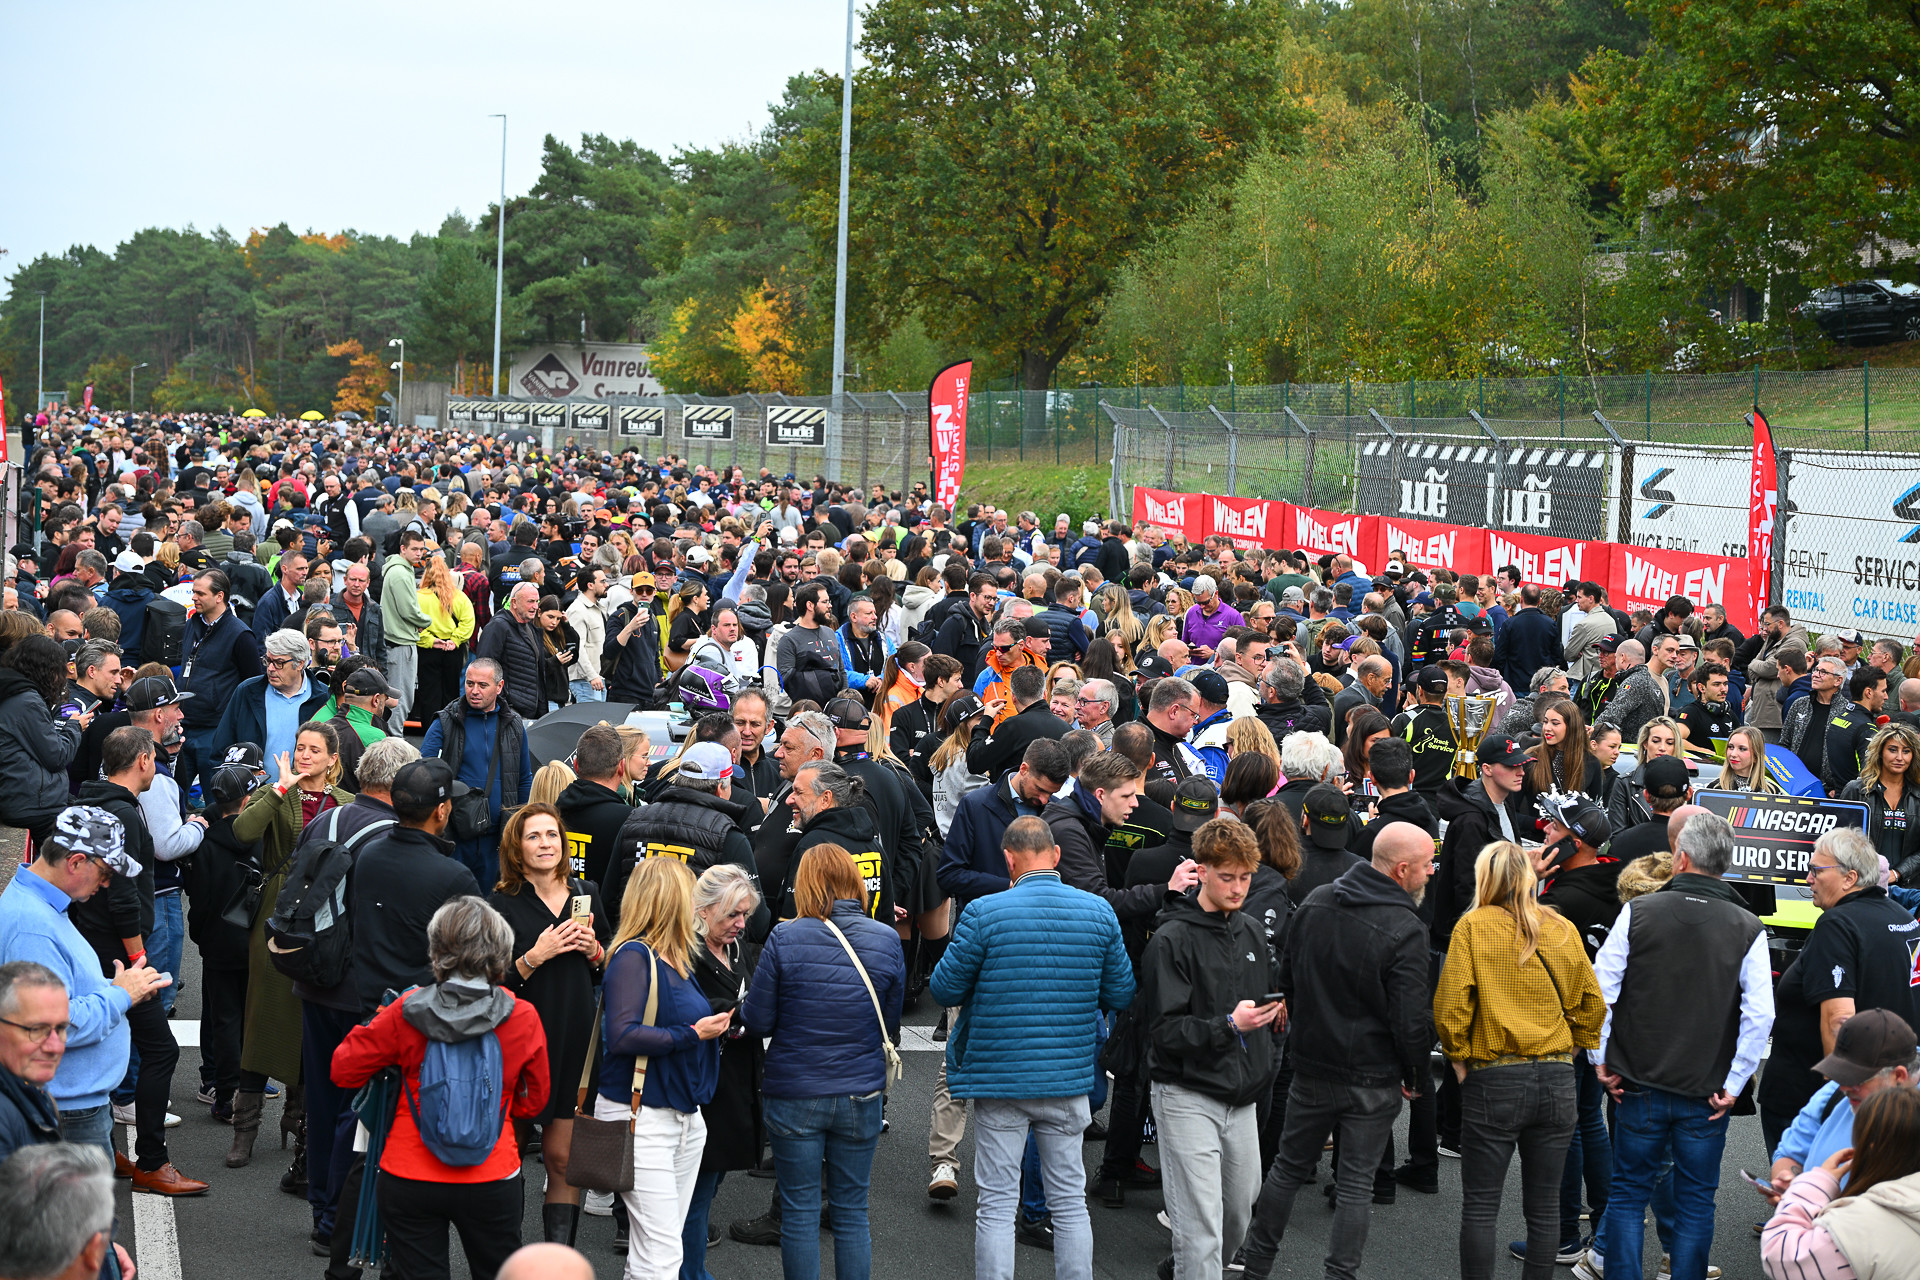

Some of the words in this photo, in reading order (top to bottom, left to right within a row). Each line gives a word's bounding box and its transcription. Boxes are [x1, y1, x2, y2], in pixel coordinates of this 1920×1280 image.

[1145, 493, 1185, 526] WHELEN
[1213, 497, 1268, 538] WHELEN
[1296, 508, 1359, 556] WHELEN
[1387, 523, 1456, 568] WHELEN
[1490, 532, 1583, 587] WHELEN
[1788, 549, 1828, 579] RENT
[1854, 555, 1920, 591] SERVIC
[1625, 551, 1726, 607] WHELEN
[1786, 589, 1826, 612] RENTAL
[1853, 598, 1879, 618] CAR
[1882, 600, 1917, 624] LEASE
[225, 747, 248, 762] 34
[1427, 742, 1454, 753] Service
[1752, 808, 1838, 835] NASCAR
[1732, 845, 1771, 868] URO
[1775, 852, 1812, 872] SER
